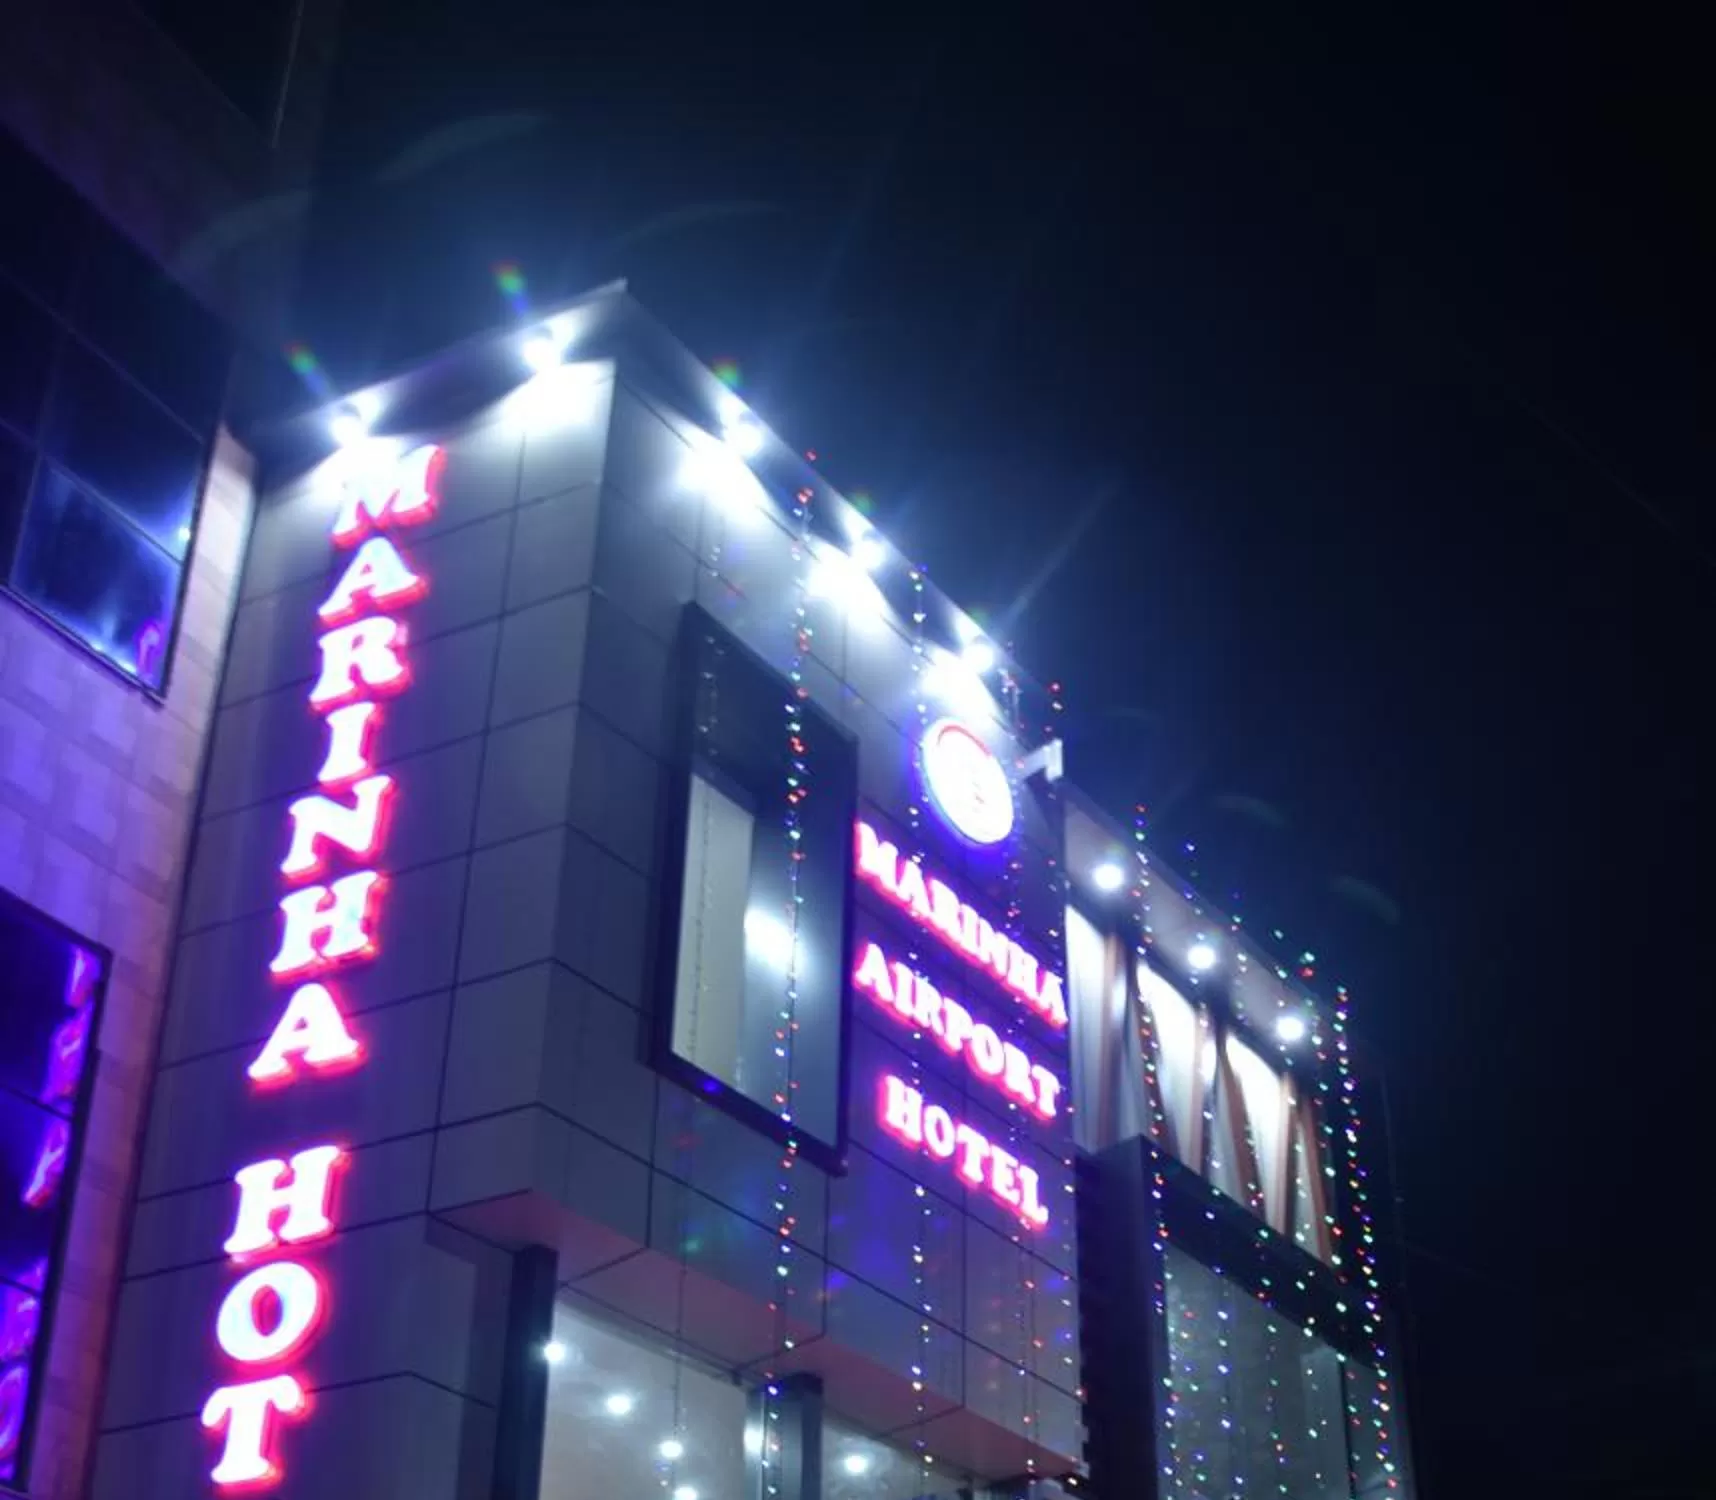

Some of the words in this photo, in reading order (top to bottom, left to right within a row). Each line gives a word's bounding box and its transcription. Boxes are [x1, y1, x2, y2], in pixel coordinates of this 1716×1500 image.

[250, 438, 444, 1092] MARINHA
[855, 820, 1069, 1029] MARINHA
[855, 942, 1060, 1120] AIRPORT
[881, 1074, 1050, 1230] HOTEL
